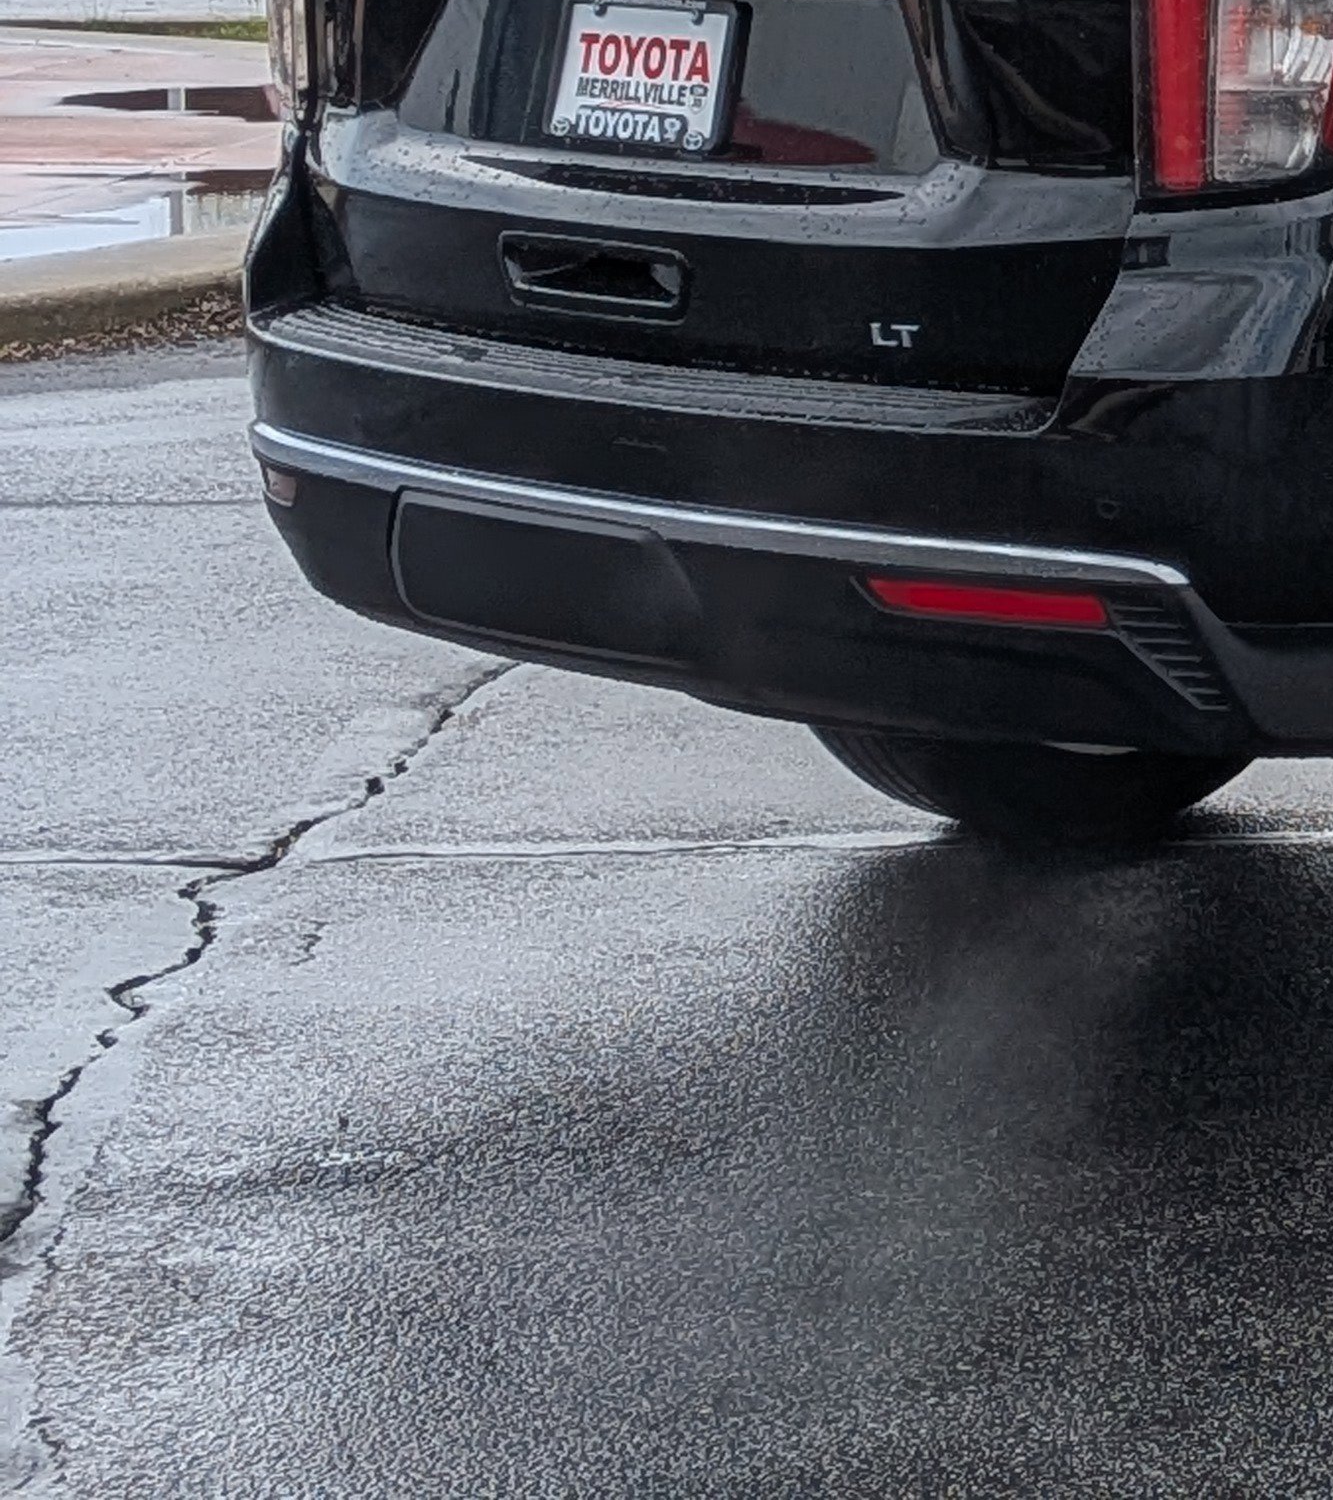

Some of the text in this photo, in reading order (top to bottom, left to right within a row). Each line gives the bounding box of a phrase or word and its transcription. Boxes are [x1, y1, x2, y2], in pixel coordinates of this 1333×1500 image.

[580, 33, 710, 83] TOYOTA
[576, 77, 687, 106] MERRILLVILLE
[577, 109, 661, 143] TOYOTA
[869, 322, 920, 348] LT
